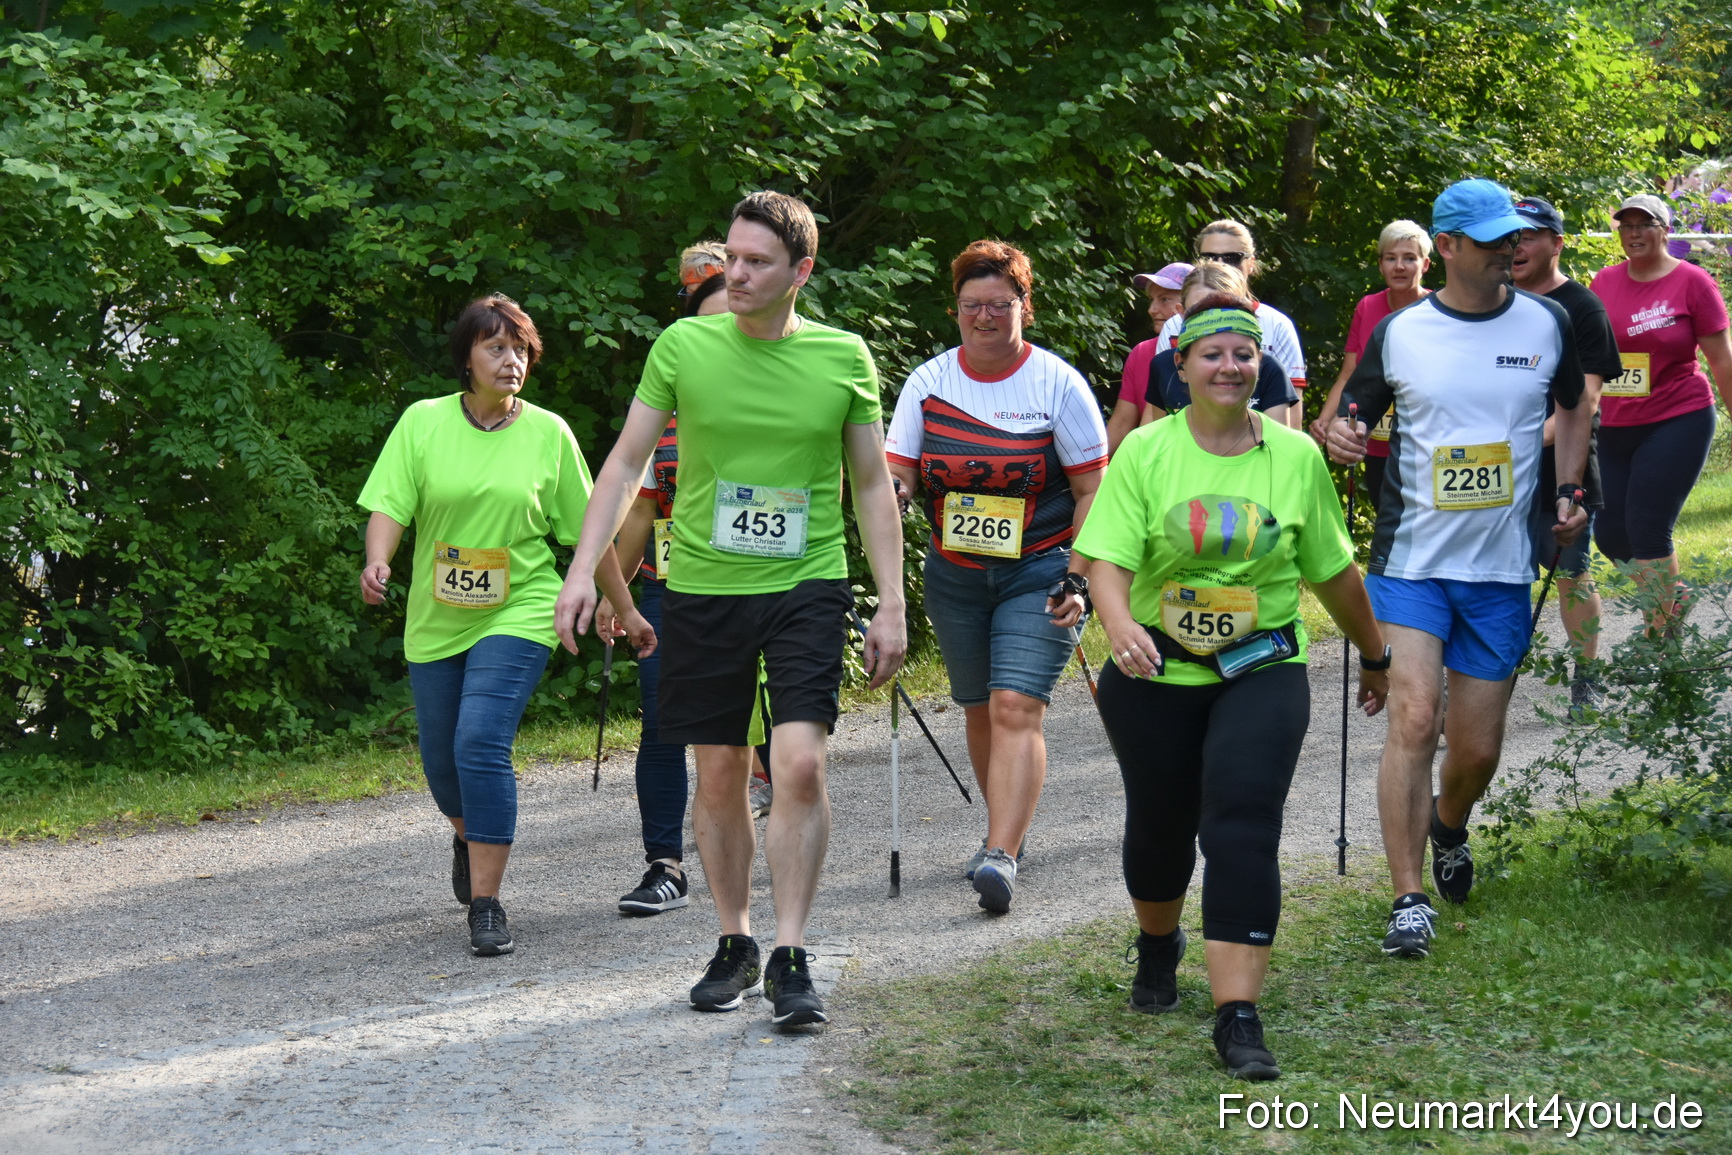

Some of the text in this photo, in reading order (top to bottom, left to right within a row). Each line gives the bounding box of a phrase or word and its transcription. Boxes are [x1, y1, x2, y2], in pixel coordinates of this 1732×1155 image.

[1495, 355, 1529, 366] swn
[993, 411, 1043, 421] NEUMARKT
[1442, 464, 1502, 491] 2281
[1446, 491, 1480, 499] Steinmetz
[731, 509, 786, 538] 453
[951, 513, 1012, 540] 2266
[730, 534, 787, 546] Lutter Christian
[958, 535, 1004, 547] Sossau Martina
[732, 542, 754, 550] Camping
[444, 567, 492, 592] 454
[440, 587, 464, 598] Maniotis
[445, 595, 463, 603] Camping
[1177, 610, 1234, 637] 456
[1178, 633, 1206, 644] Schmid
